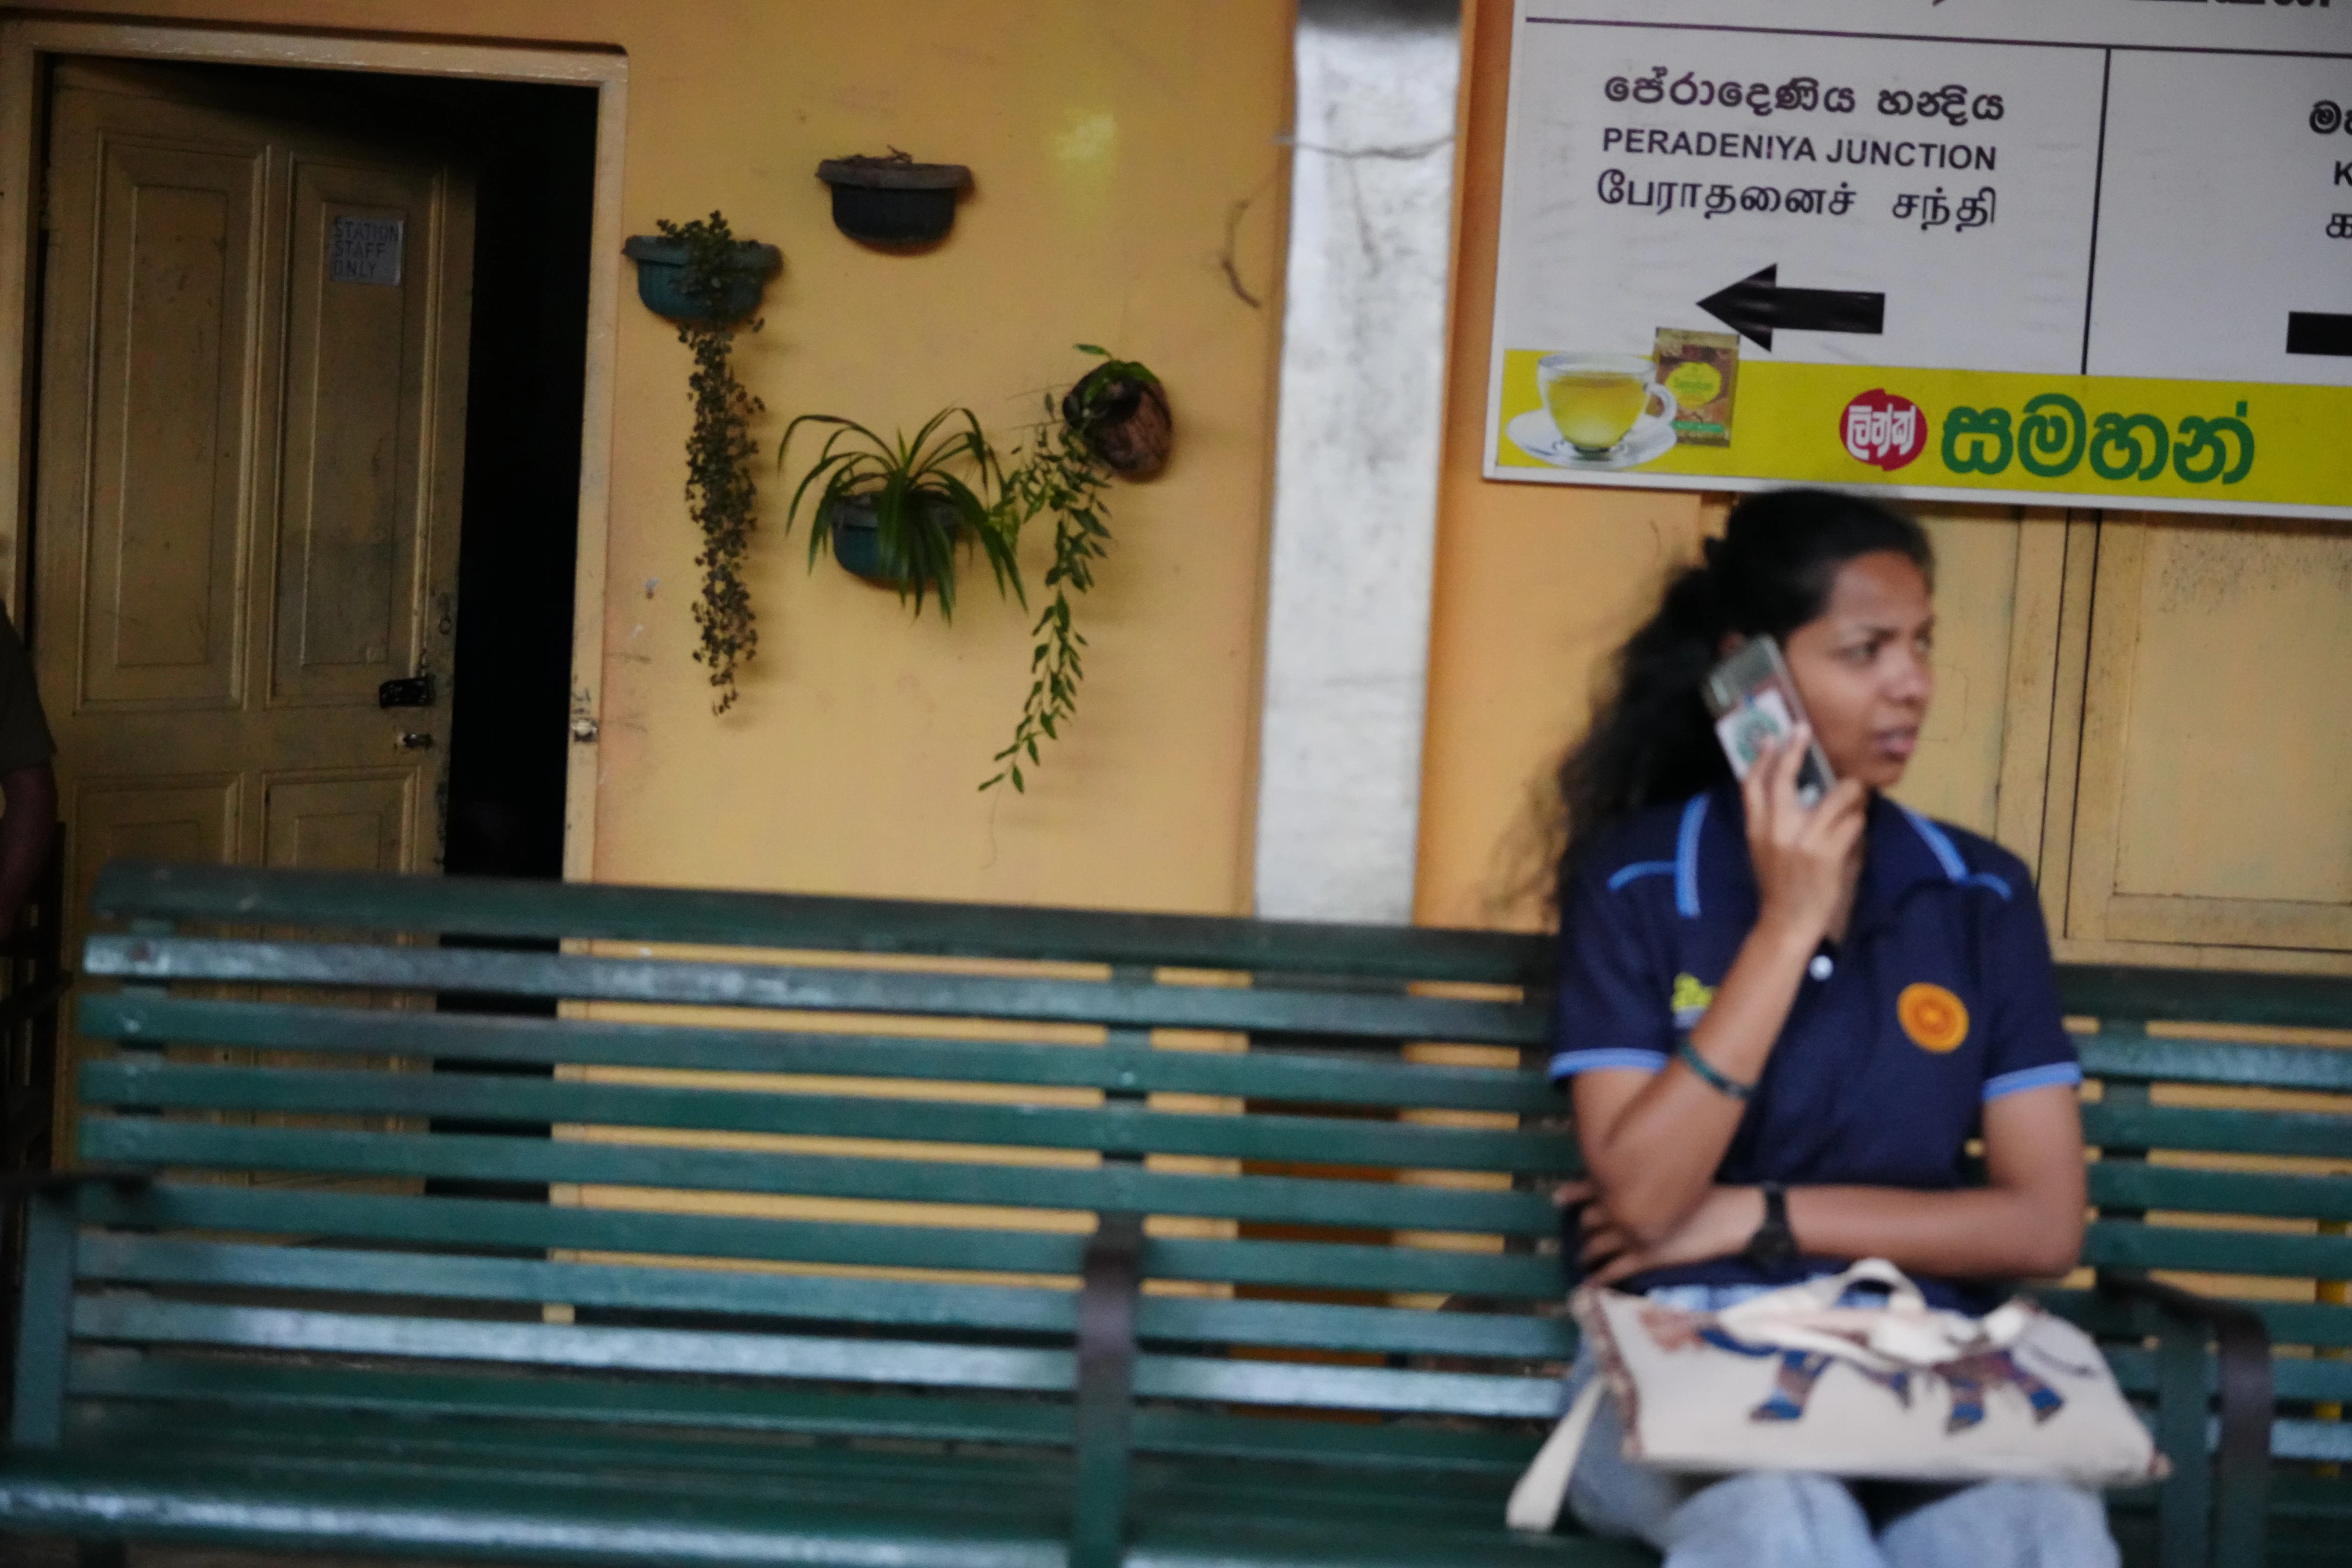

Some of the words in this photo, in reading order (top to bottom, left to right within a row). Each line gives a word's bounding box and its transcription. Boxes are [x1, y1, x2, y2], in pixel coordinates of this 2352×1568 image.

[1602, 127, 1817, 162] PERADENIYA
[1826, 138, 1997, 172] JUNCTION
[1596, 168, 1857, 220] பேராதனைச்
[1891, 186, 1997, 233] சந்தி
[334, 218, 399, 241] STATION
[334, 240, 385, 258] STAFF
[333, 260, 376, 278] ONLY
[1942, 394, 2255, 484] සමහන්
